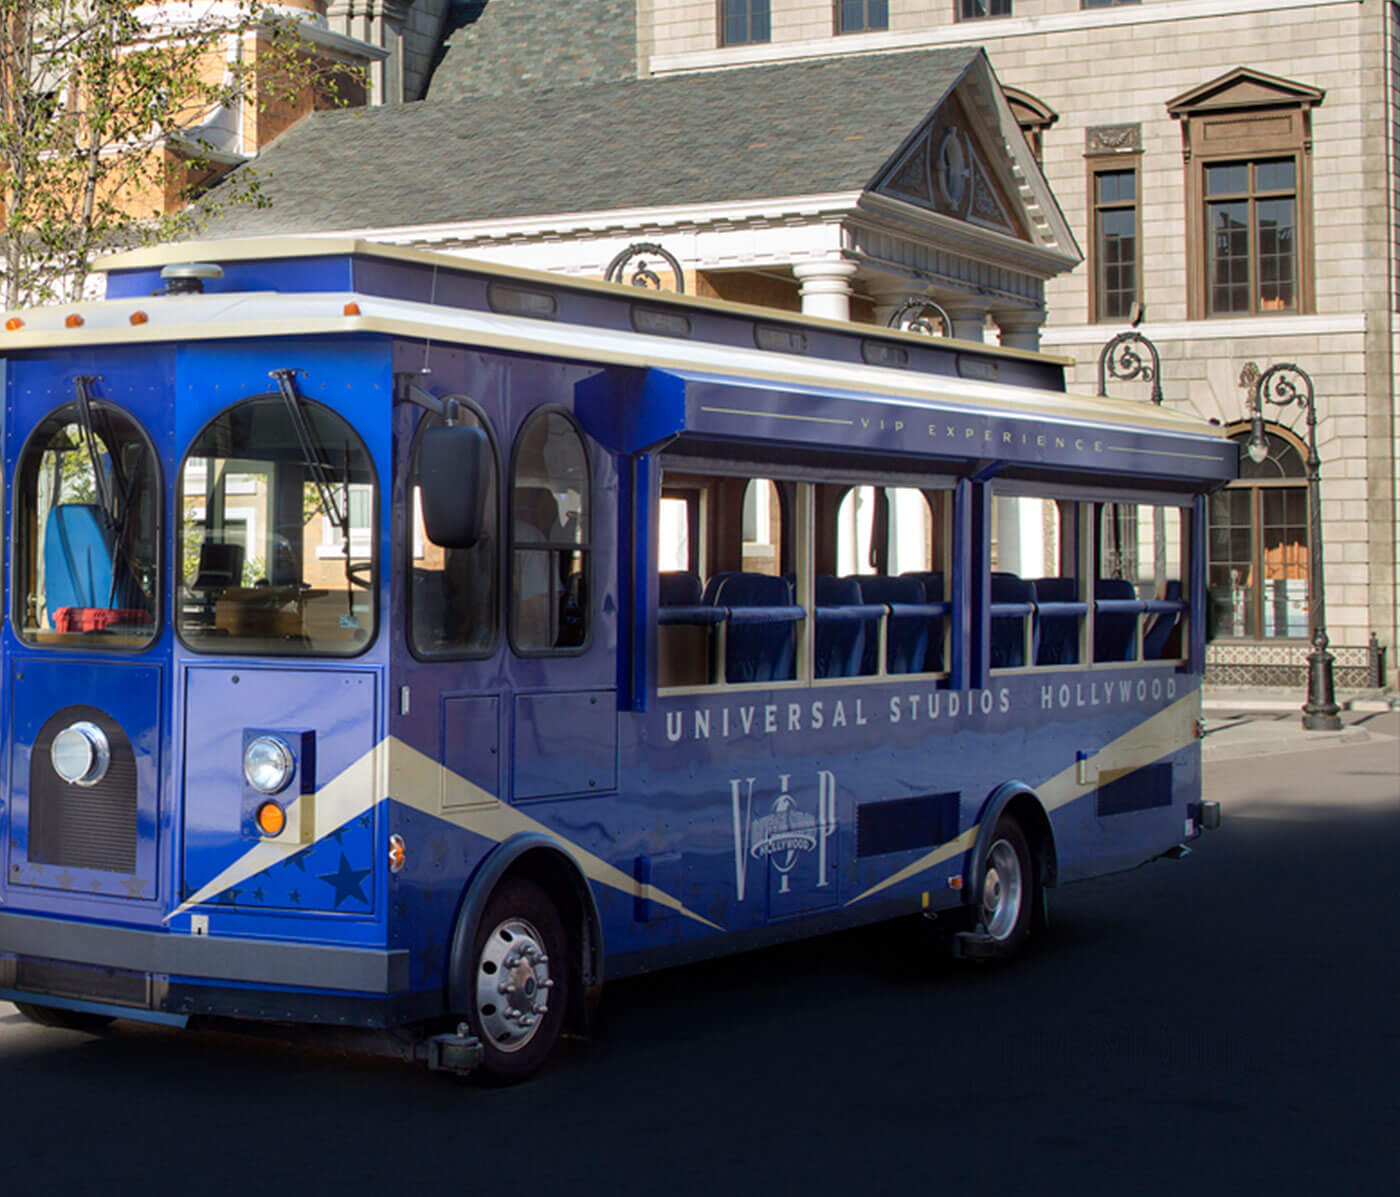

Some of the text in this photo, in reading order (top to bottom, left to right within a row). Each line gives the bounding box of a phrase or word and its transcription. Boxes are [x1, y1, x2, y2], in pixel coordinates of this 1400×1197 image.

[861, 418, 1103, 452] VIP EXPERIENCE
[666, 678, 1177, 741] UNIVERSAL STUDIOS HOLLYWOOD
[729, 770, 835, 901] VIP
